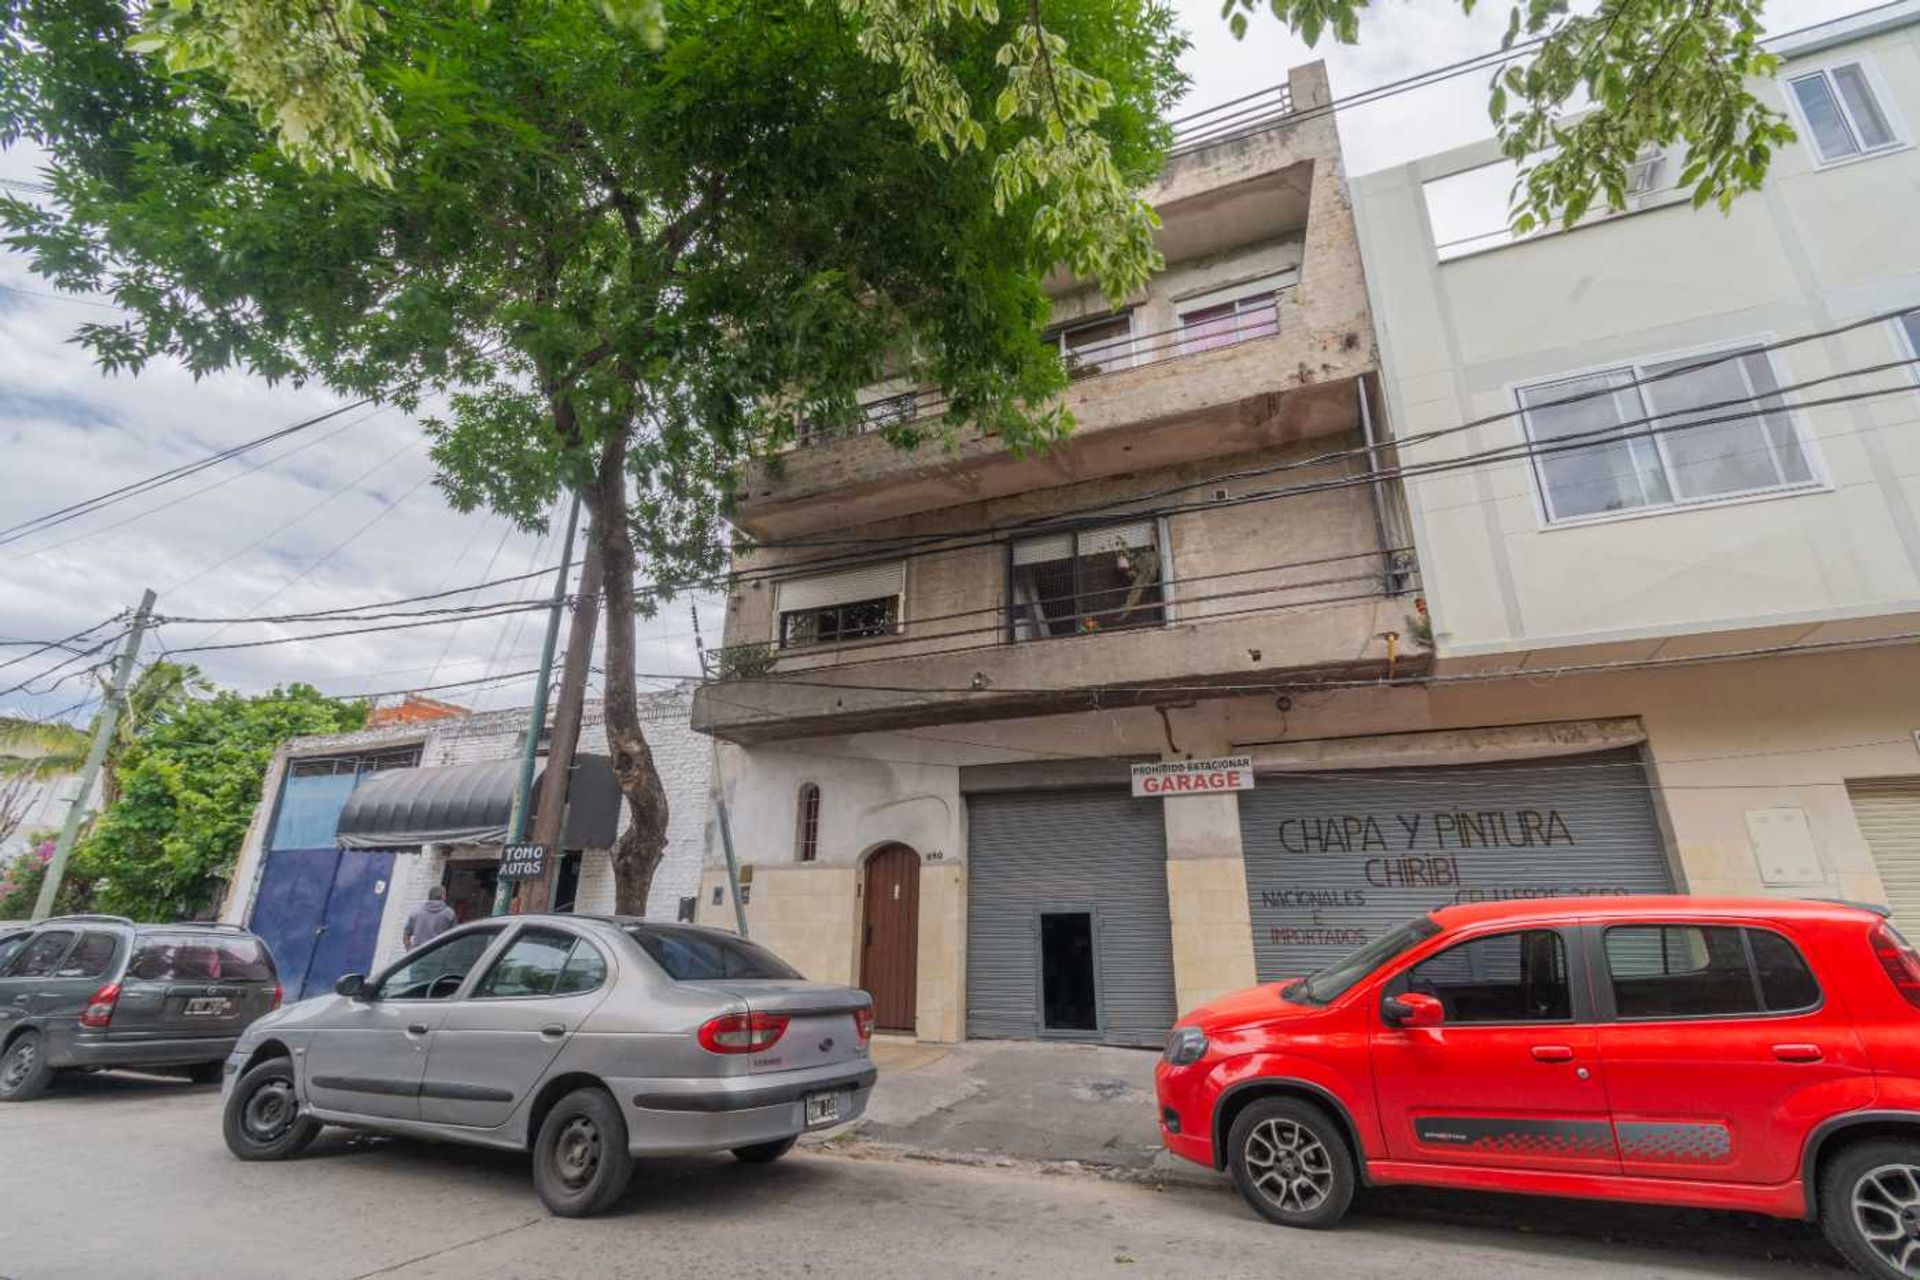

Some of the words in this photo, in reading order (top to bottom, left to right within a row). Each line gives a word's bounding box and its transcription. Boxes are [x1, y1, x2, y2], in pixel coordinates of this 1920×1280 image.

[1133, 763, 1185, 775] PROHIBIDO
[1187, 758, 1250, 772] ESTACIONAR
[1143, 770, 1241, 793] GARAGE
[1278, 815, 1388, 854] CHAPA
[1396, 813, 1421, 849] Y
[1434, 807, 1575, 849] PINTURA
[505, 846, 543, 861] TOMO
[499, 861, 542, 875] AUTOS
[1262, 886, 1366, 908] NACIONALES
[1270, 925, 1369, 945] IMPORTADOS
